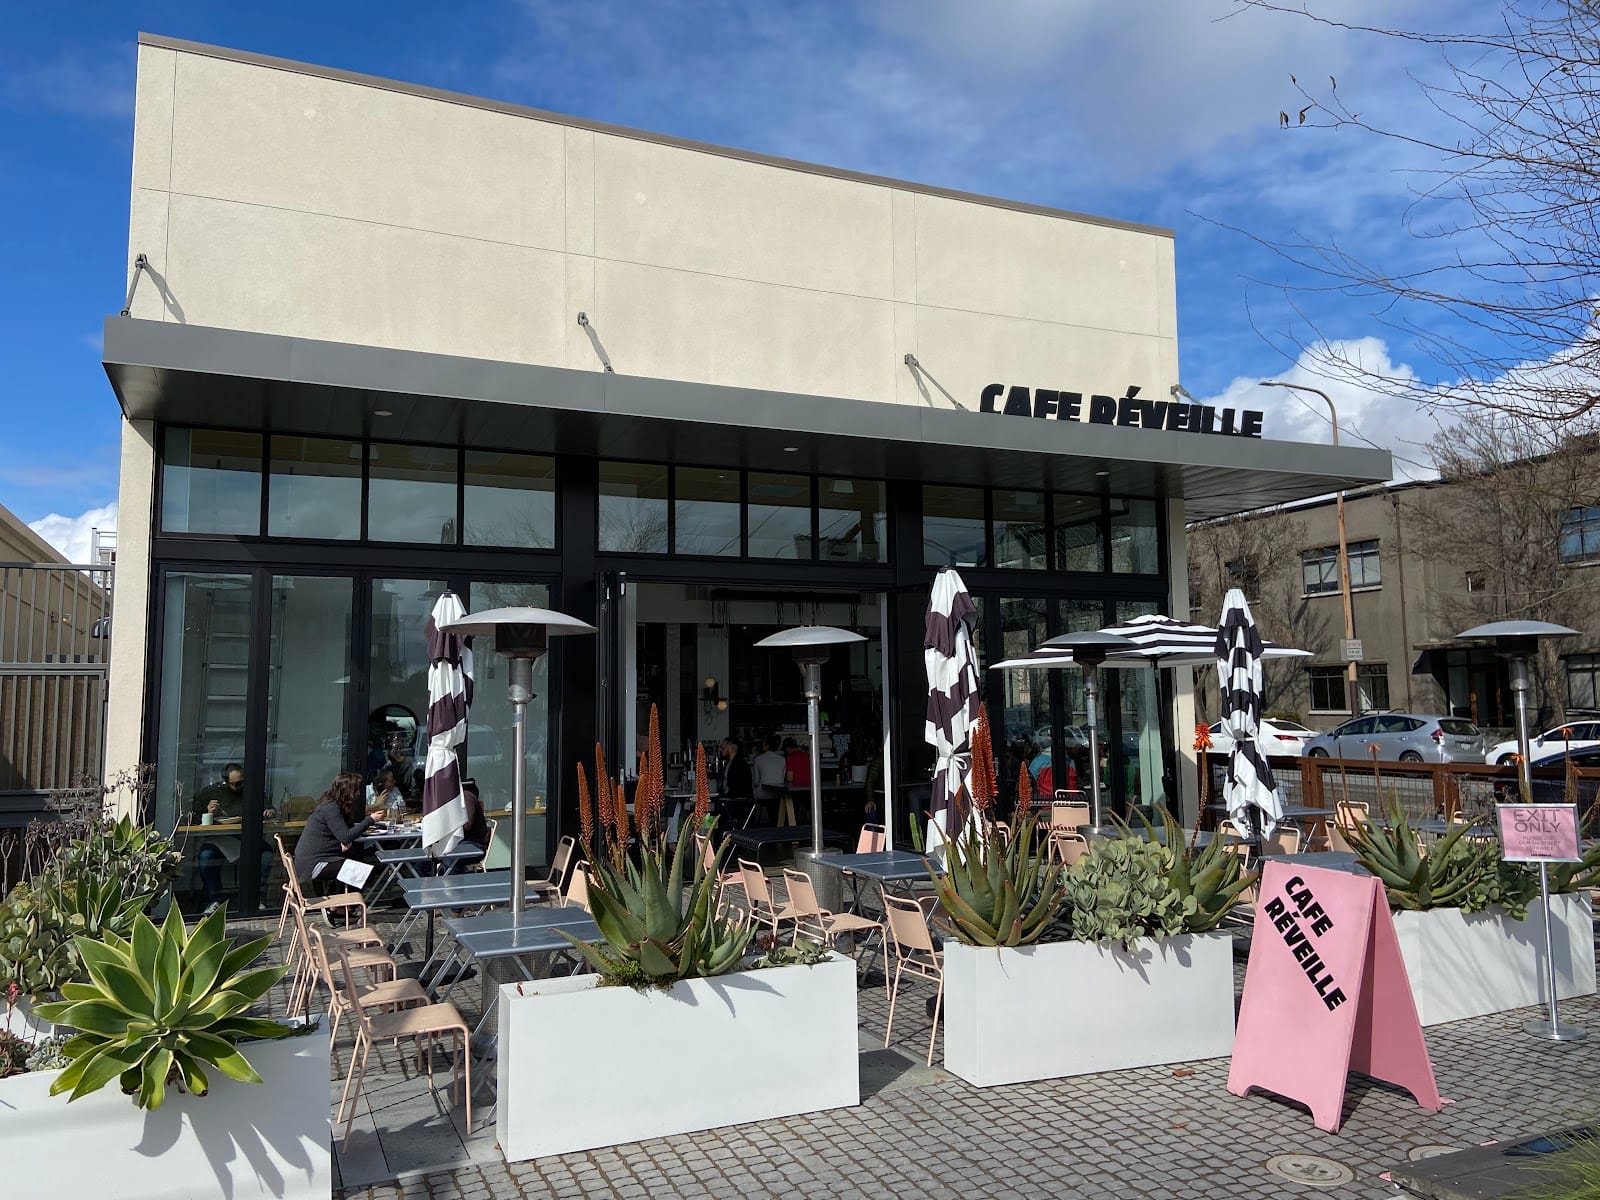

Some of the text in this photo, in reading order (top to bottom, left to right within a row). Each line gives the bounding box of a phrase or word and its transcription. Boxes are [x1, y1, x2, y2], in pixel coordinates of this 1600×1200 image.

[980, 383, 1263, 438] CAFE RÉVEILLE
[1513, 809, 1560, 822] EXIT
[1514, 822, 1561, 833] ONLY
[1285, 876, 1334, 938] CAFE
[1264, 896, 1347, 1012] RÉVEILLE
